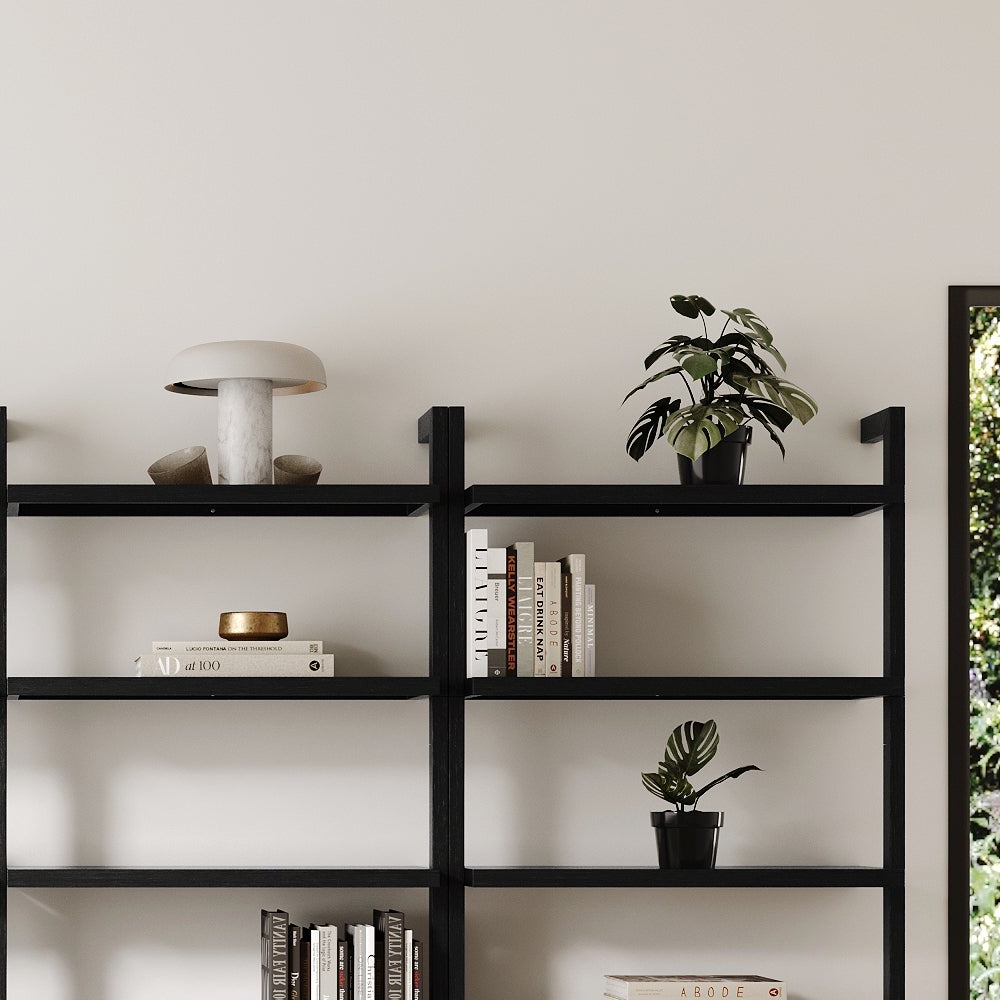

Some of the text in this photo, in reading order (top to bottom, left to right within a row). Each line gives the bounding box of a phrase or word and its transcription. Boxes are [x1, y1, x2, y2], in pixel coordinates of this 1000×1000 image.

[508, 555, 516, 671] KELLY WEARSTLER
[518, 576, 532, 645] LIAIGRE
[536, 577, 544, 662] EAT DRINK NAP
[550, 600, 559, 647] ABODE
[156, 656, 180, 676] AD
[185, 660, 221, 671] at 100
[290, 972, 299, 986] Dior
[681, 986, 744, 998] ABODE
